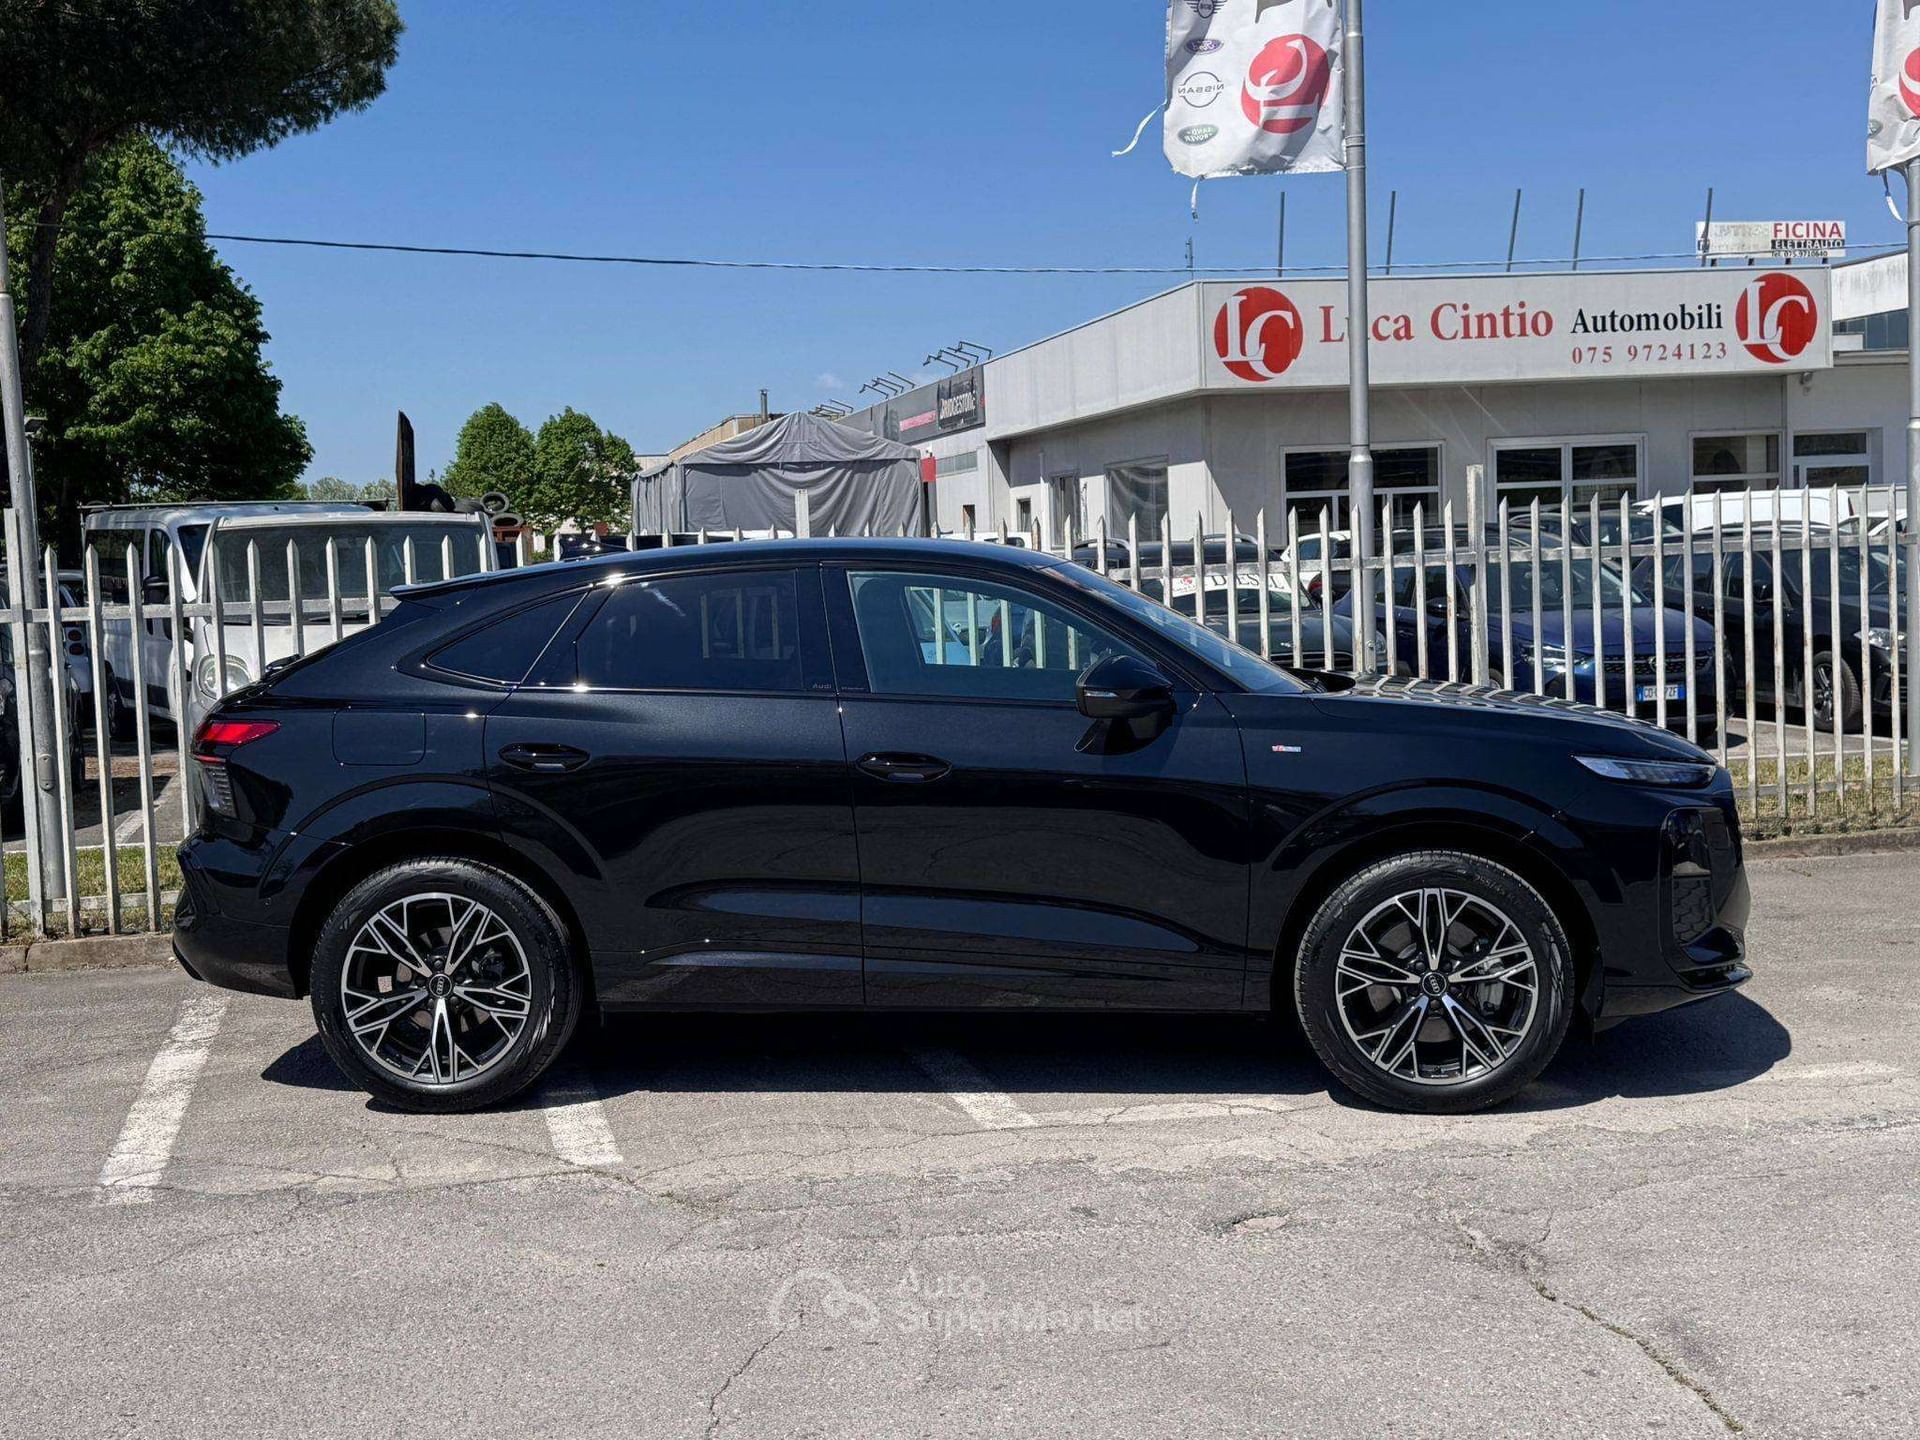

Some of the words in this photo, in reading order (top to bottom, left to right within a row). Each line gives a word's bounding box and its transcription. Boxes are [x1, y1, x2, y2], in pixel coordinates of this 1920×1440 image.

[1773, 222, 1843, 239] FICINA
[1775, 239, 1843, 249] ELETTRAUTO
[1319, 305, 1415, 343] Lca
[1430, 301, 1554, 341] Cintio
[1570, 303, 1724, 334] Automobili
[1572, 346, 1613, 364] 075
[1627, 341, 1728, 362] 9724123
[1211, 573, 1285, 589] DESL
